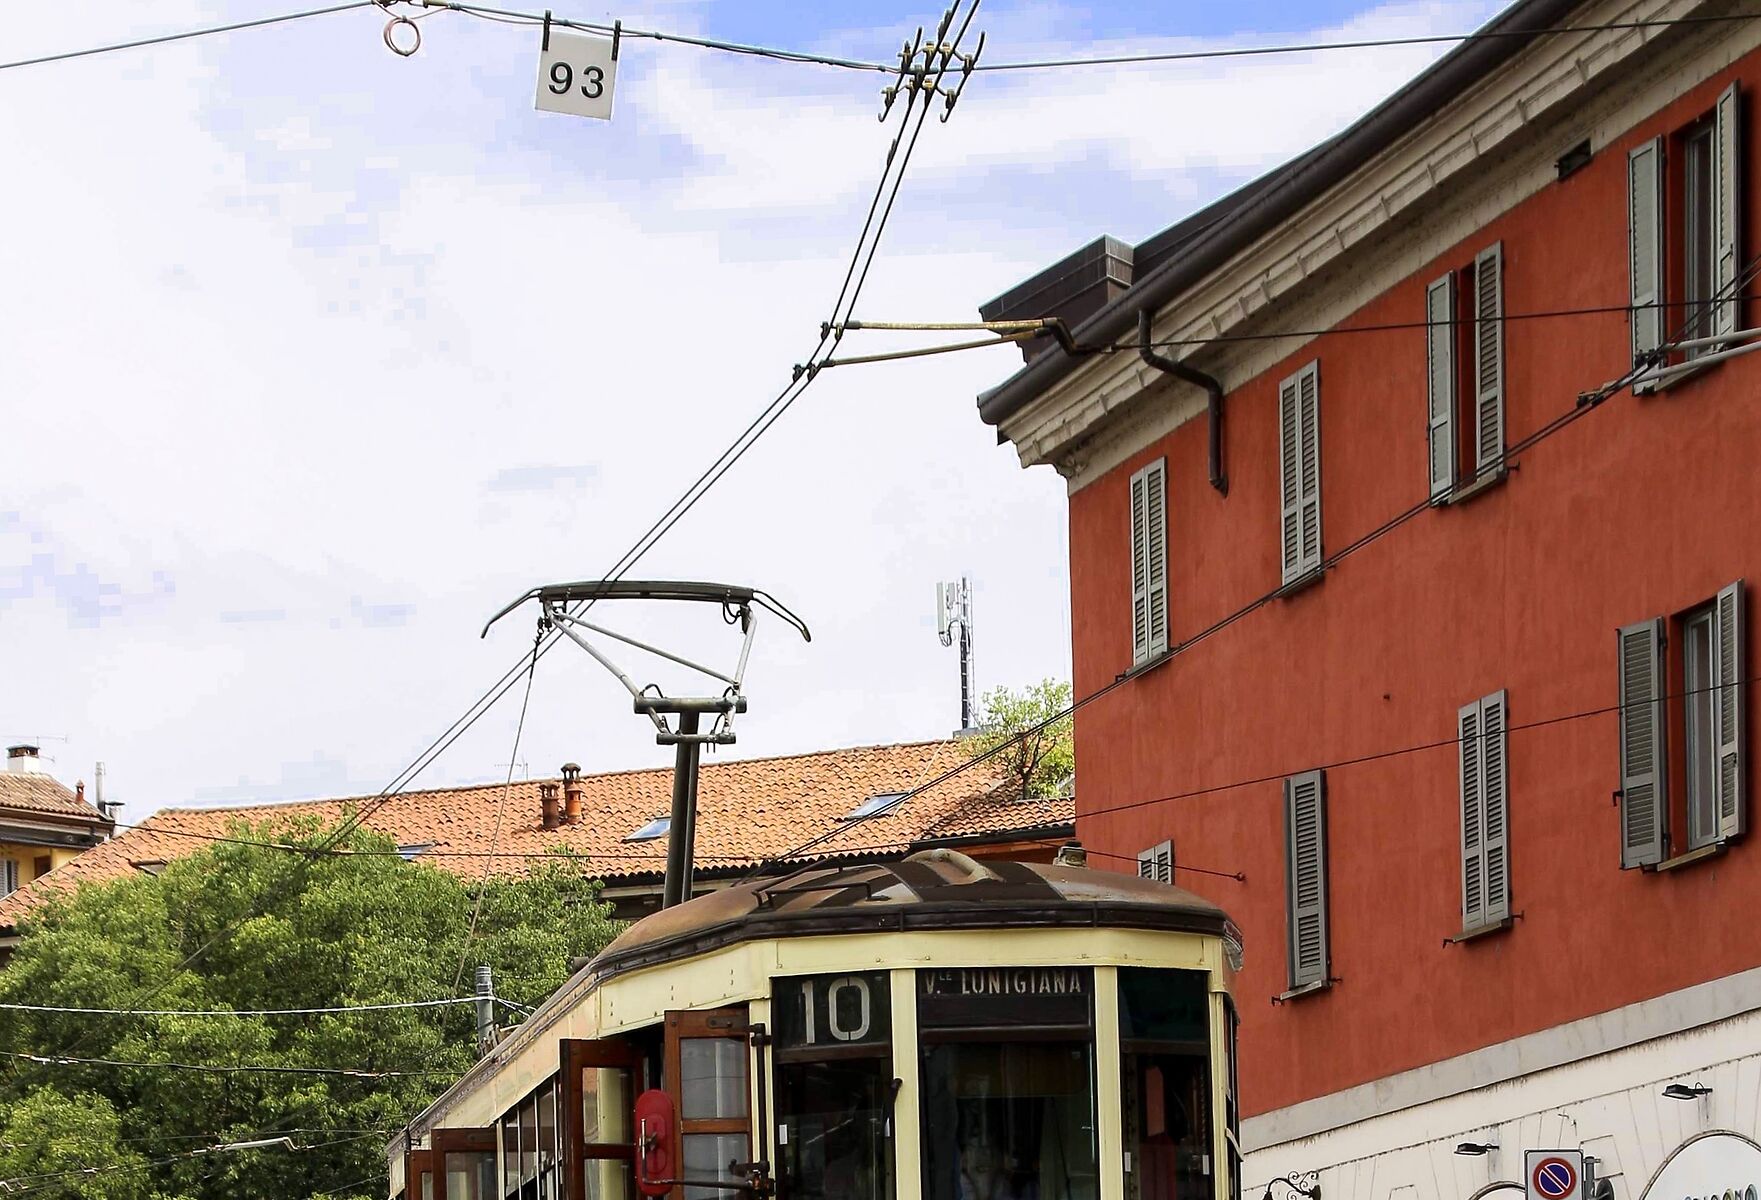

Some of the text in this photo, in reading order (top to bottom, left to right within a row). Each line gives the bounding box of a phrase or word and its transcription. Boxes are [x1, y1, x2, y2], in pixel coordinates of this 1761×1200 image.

[548, 61, 605, 99] 93
[961, 967, 1082, 994] LUNIGIANA
[800, 976, 870, 1044] 10
